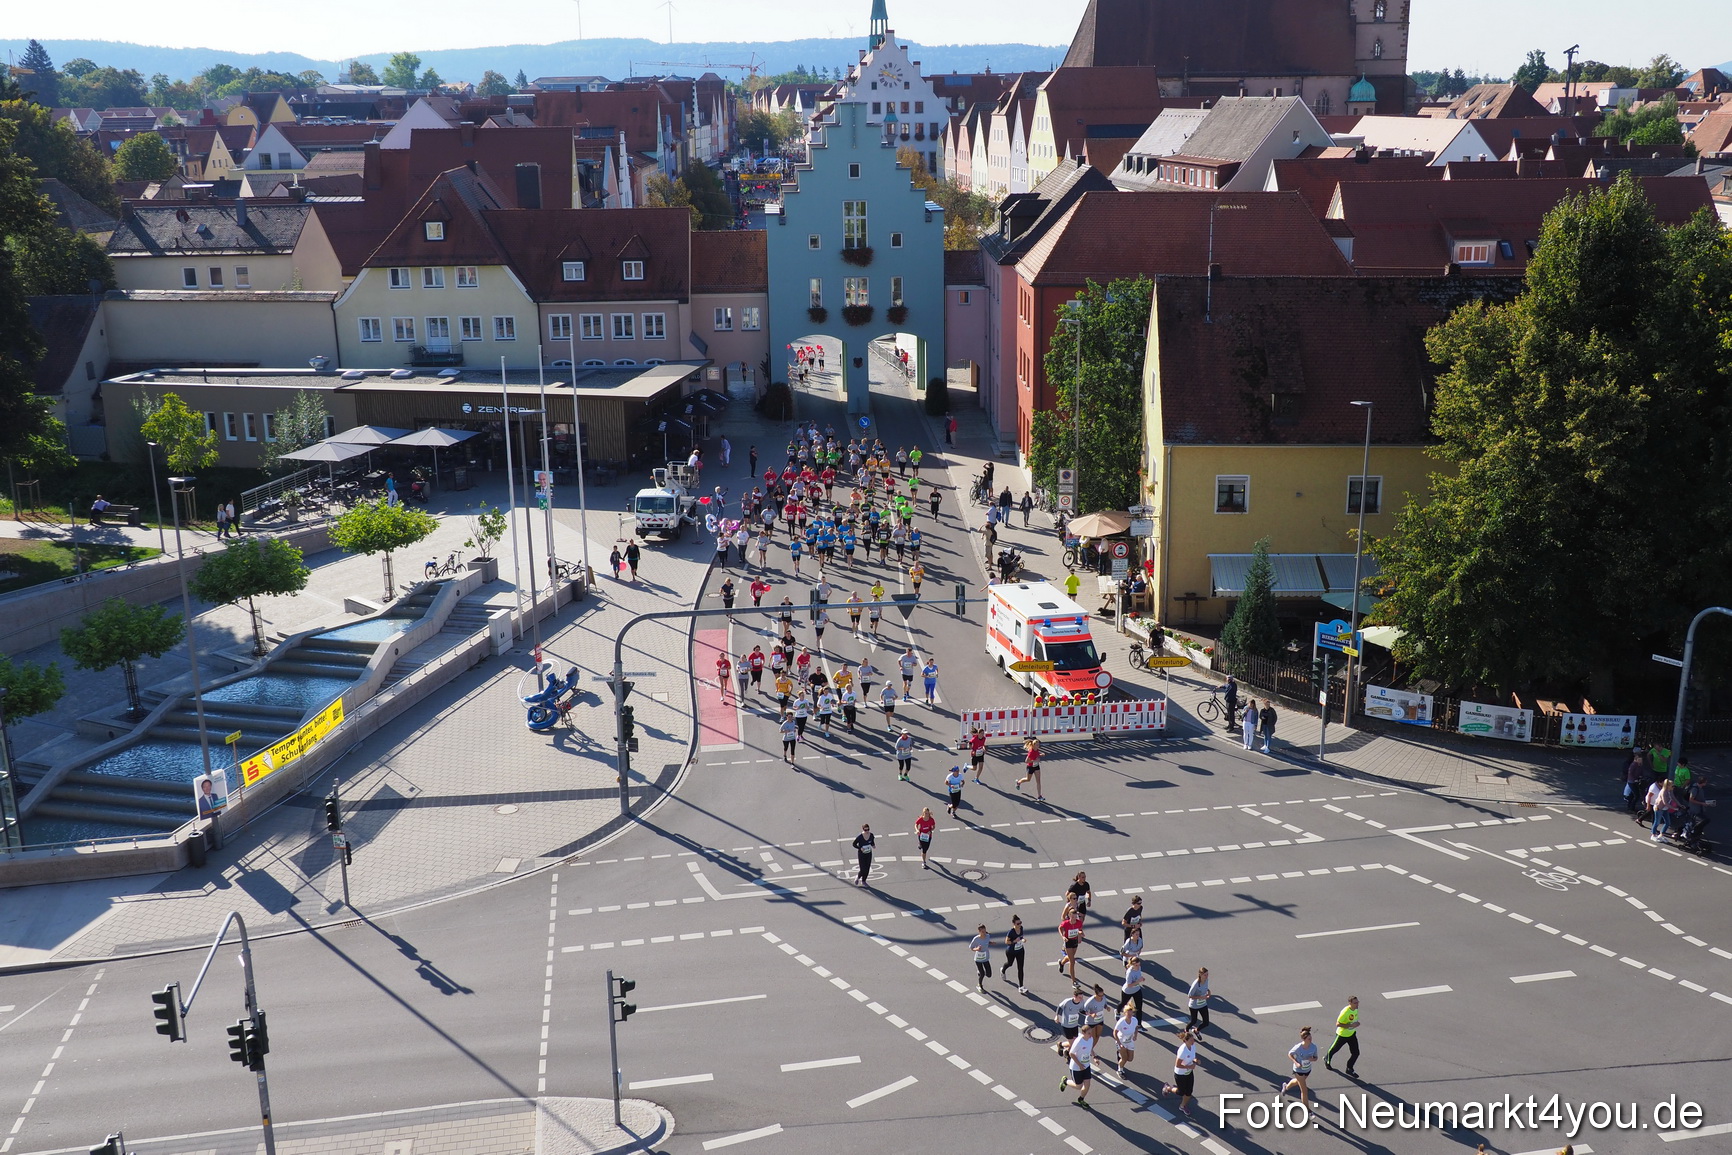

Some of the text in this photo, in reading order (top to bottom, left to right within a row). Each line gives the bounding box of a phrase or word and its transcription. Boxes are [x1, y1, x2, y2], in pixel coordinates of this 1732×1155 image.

[271, 739, 296, 756] Tempo
[314, 712, 327, 728] bitte!
[281, 734, 317, 763] Schulanfang
